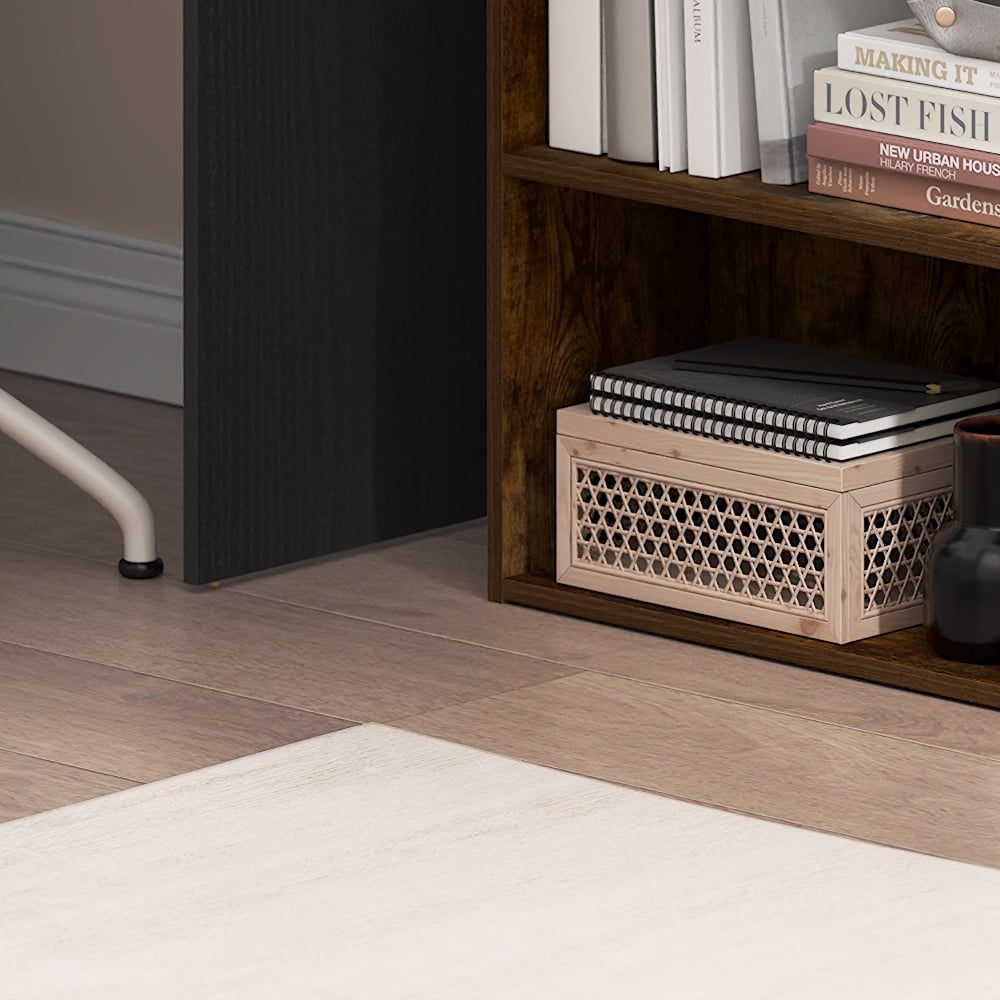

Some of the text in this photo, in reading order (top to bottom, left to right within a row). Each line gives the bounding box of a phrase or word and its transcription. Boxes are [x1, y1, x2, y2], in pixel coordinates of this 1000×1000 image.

[854, 46, 978, 85] MAKING IT
[824, 83, 992, 142] LOST FISH
[879, 142, 911, 160] NEW
[913, 148, 960, 170] URBAN
[879, 157, 957, 180] HILARY FRENCH
